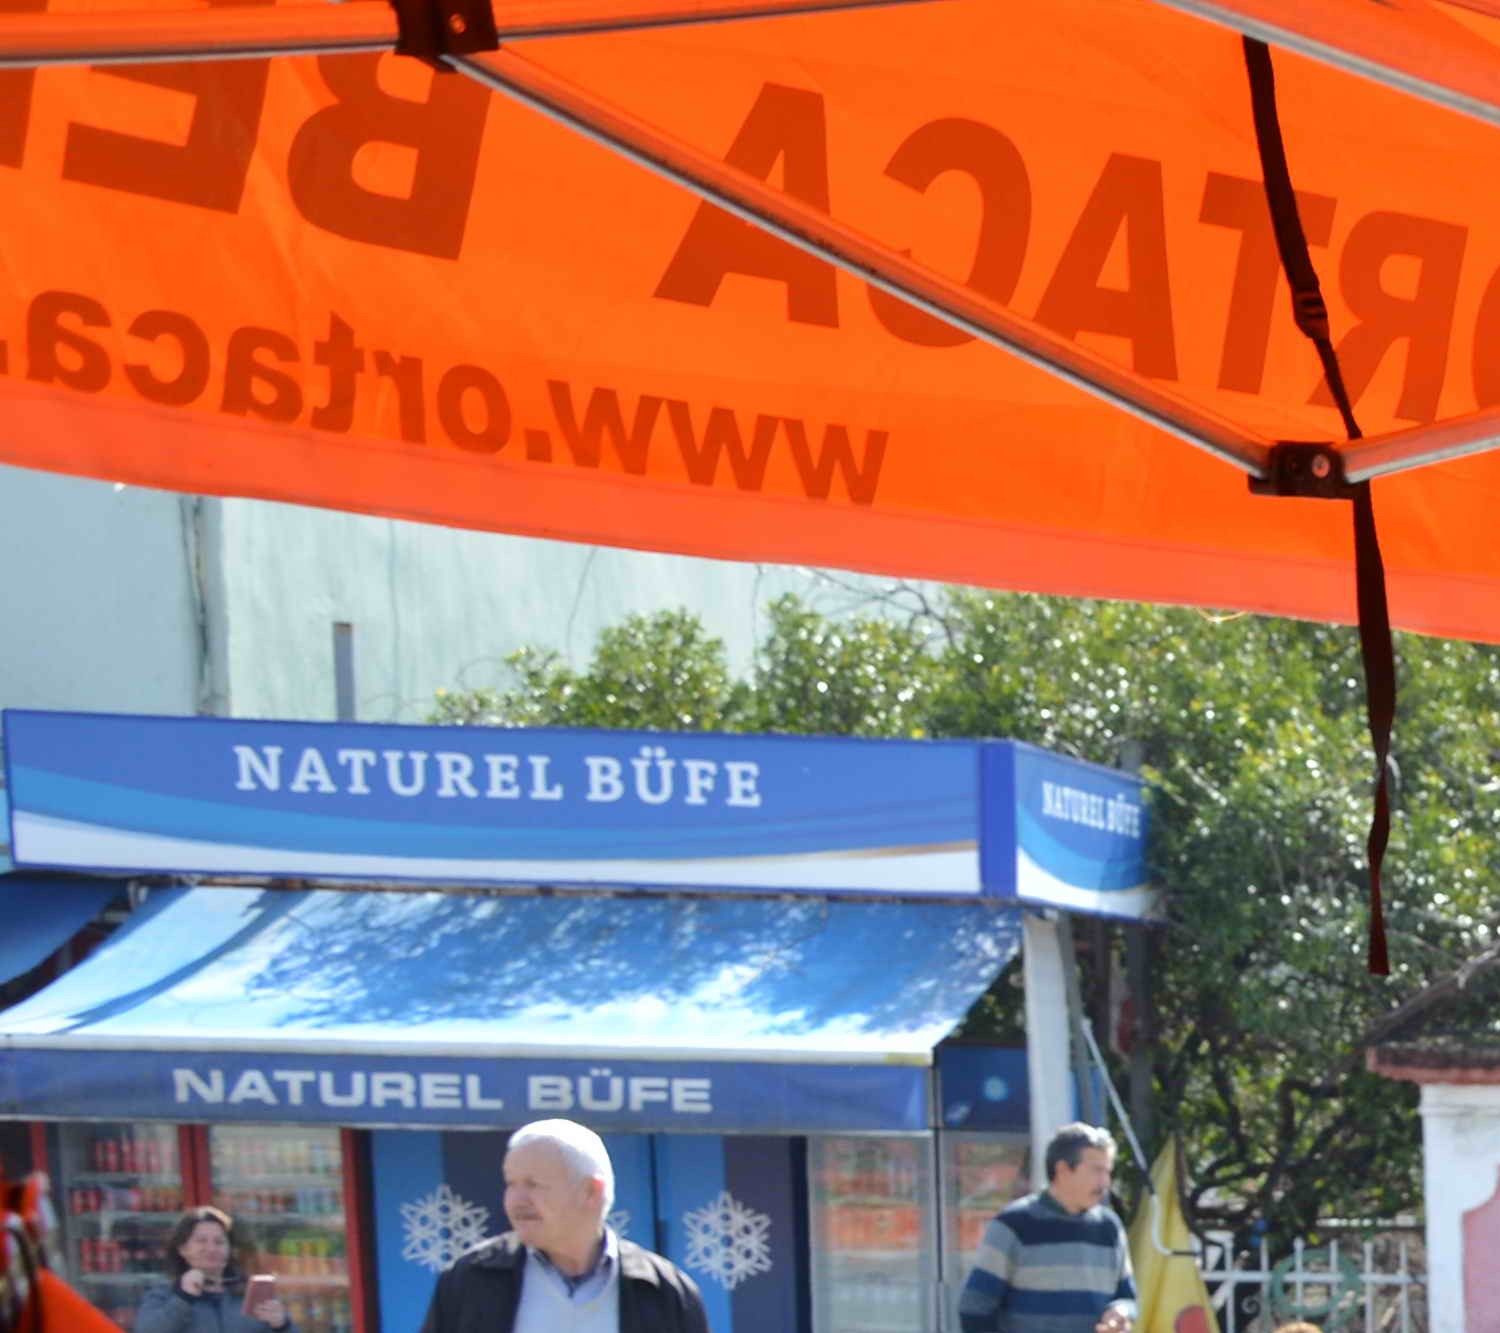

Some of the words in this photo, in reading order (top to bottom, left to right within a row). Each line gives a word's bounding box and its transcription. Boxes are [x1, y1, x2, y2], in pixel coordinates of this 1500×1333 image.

[233, 745, 563, 801] NATUREL
[585, 746, 762, 807] BÜFE
[172, 1068, 503, 1111] NATUREL
[527, 1068, 712, 1113] BÜFE
